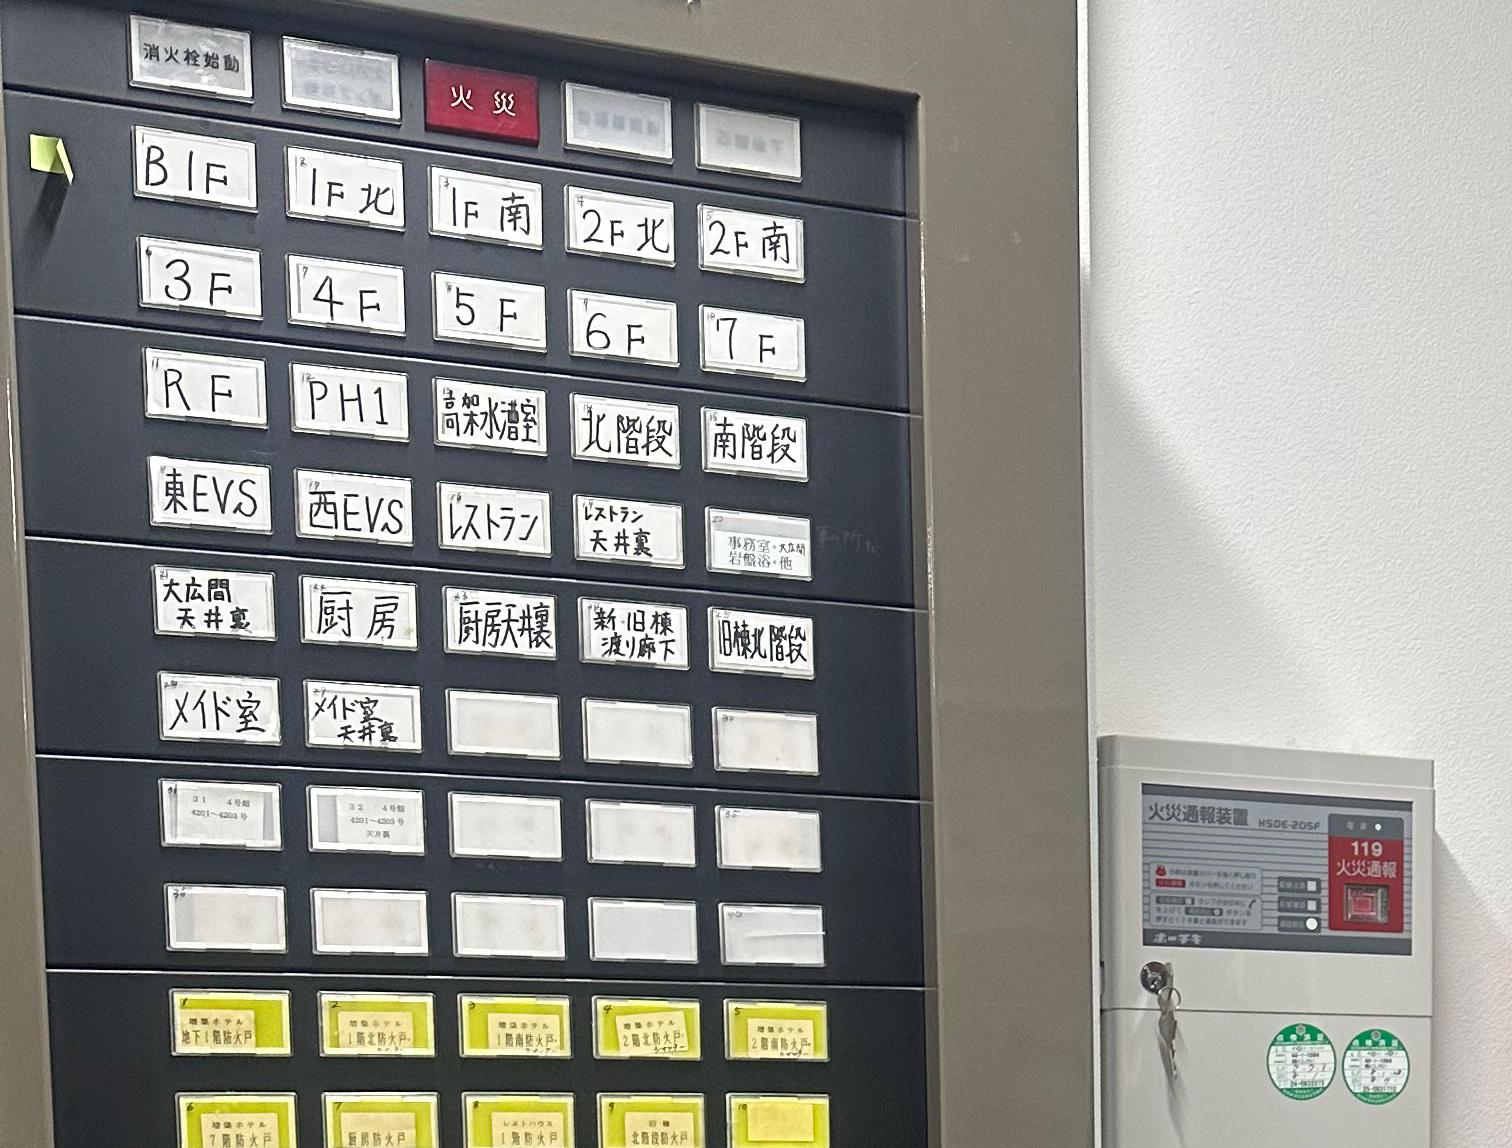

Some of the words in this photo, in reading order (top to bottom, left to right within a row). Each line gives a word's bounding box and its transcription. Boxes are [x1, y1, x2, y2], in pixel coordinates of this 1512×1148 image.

[142, 42, 241, 73] 消火栓始動
[450, 84, 516, 117] 火災
[145, 145, 228, 195] B1F
[164, 258, 232, 306] 3F
[312, 275, 381, 323] 4F
[455, 286, 519, 332] 5F
[585, 312, 646, 355] 6F
[715, 317, 777, 363] 7F
[163, 368, 233, 412] RF
[309, 380, 389, 426] PH1
[581, 406, 674, 458] 北階段
[712, 417, 797, 465] 南階段
[163, 467, 259, 518] 東EVS
[308, 490, 404, 536] 西EVS
[448, 502, 540, 542] レストラン
[584, 505, 645, 525] レストラン
[589, 528, 654, 558] 天井裏
[163, 576, 231, 603] 大広間
[176, 605, 251, 631] 天井裏
[317, 590, 400, 640] 厨房
[457, 600, 554, 650] 厨房天井裏
[600, 632, 677, 663] 渡り廊下
[718, 618, 808, 666] 旧棟北階段
[168, 689, 266, 733] メイド室
[311, 695, 384, 724] メイド室
[336, 721, 399, 745] 天井裏
[1149, 801, 1250, 827] 火災通報装置
[1351, 841, 1384, 857] 119
[1336, 858, 1398, 880] 火災通報
[1153, 932, 1203, 946] ホーチキ
[603, 1004, 613, 1015] 4
[209, 1132, 273, 1148] 7階防火戸
[348, 1131, 407, 1148] 厨房防火戸
[501, 1131, 558, 1147] 1階防火戸
[503, 1120, 553, 1128] レストハウス
[631, 1131, 689, 1147] 北階段防火戸
